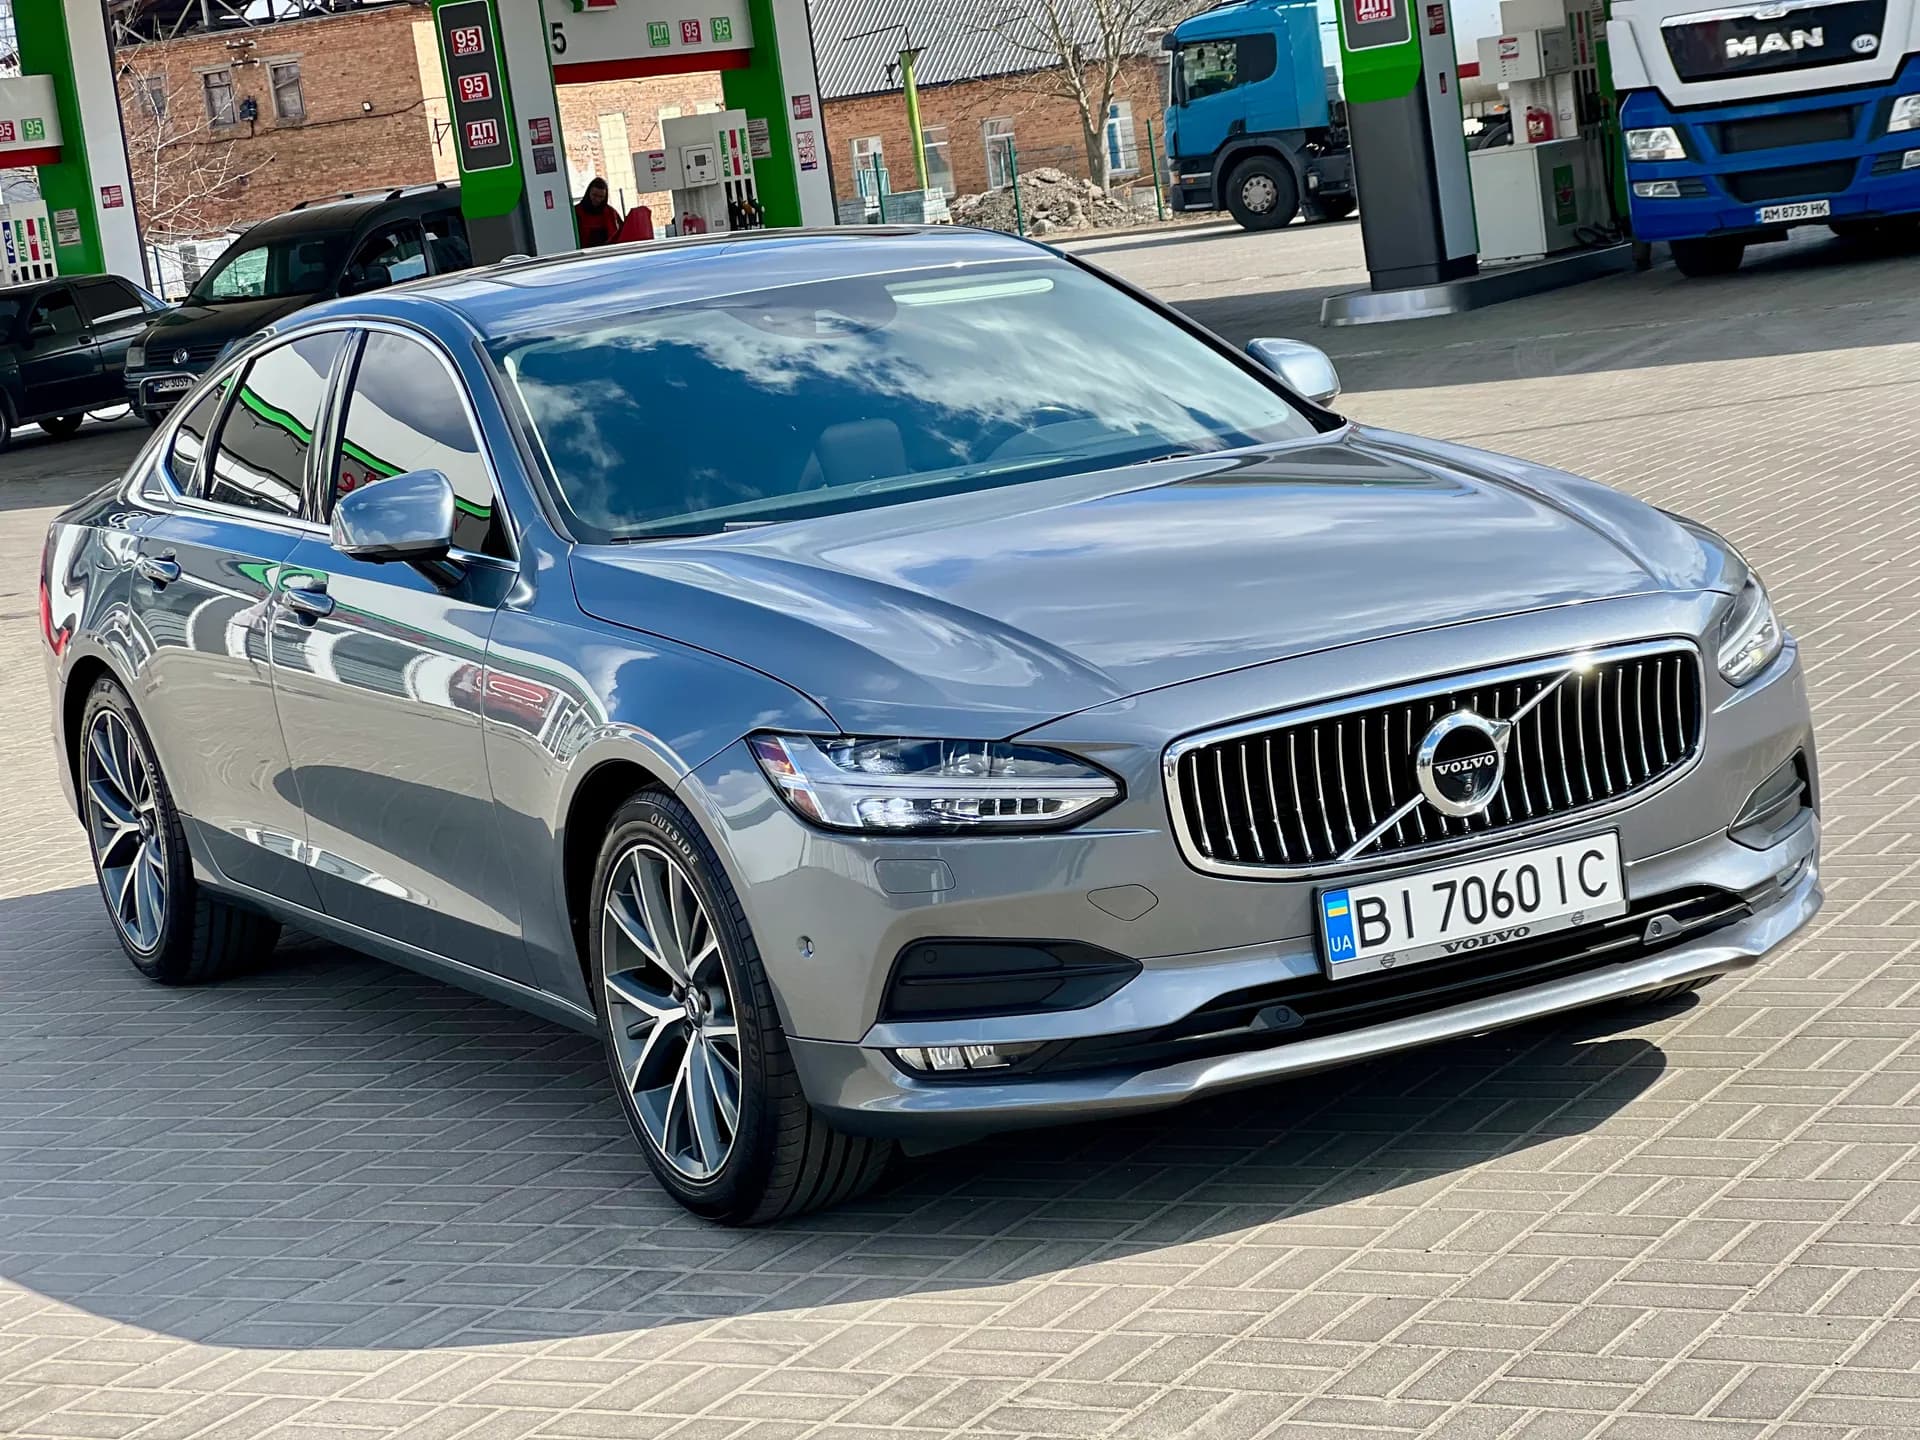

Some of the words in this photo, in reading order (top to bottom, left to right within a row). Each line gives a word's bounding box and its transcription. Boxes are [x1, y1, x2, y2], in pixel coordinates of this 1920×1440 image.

[1361, 11, 1388, 20] euro
[652, 24, 668, 40] ДП
[684, 22, 698, 37] 95
[715, 19, 730, 35] 95
[455, 29, 478, 48] 95
[551, 22, 567, 54] 5
[1725, 26, 1824, 59] MAN
[1856, 38, 1874, 49] UA
[458, 45, 479, 54] euro
[463, 77, 484, 94] 95
[26, 121, 42, 135] 95
[470, 122, 494, 141] ДП
[473, 137, 493, 146] euro
[1763, 208, 1780, 221] AM
[1782, 204, 1808, 218] 8739
[1811, 201, 1828, 215] HK
[4, 230, 15, 256] ГАЗ
[1435, 754, 1495, 775] VOLVO
[650, 812, 699, 866] OUTSIDE
[1356, 889, 1415, 949] BI
[1432, 863, 1541, 933] 7060
[1556, 849, 1608, 905] IC
[1330, 934, 1353, 953] UA
[1441, 925, 1531, 953] VOLVO
